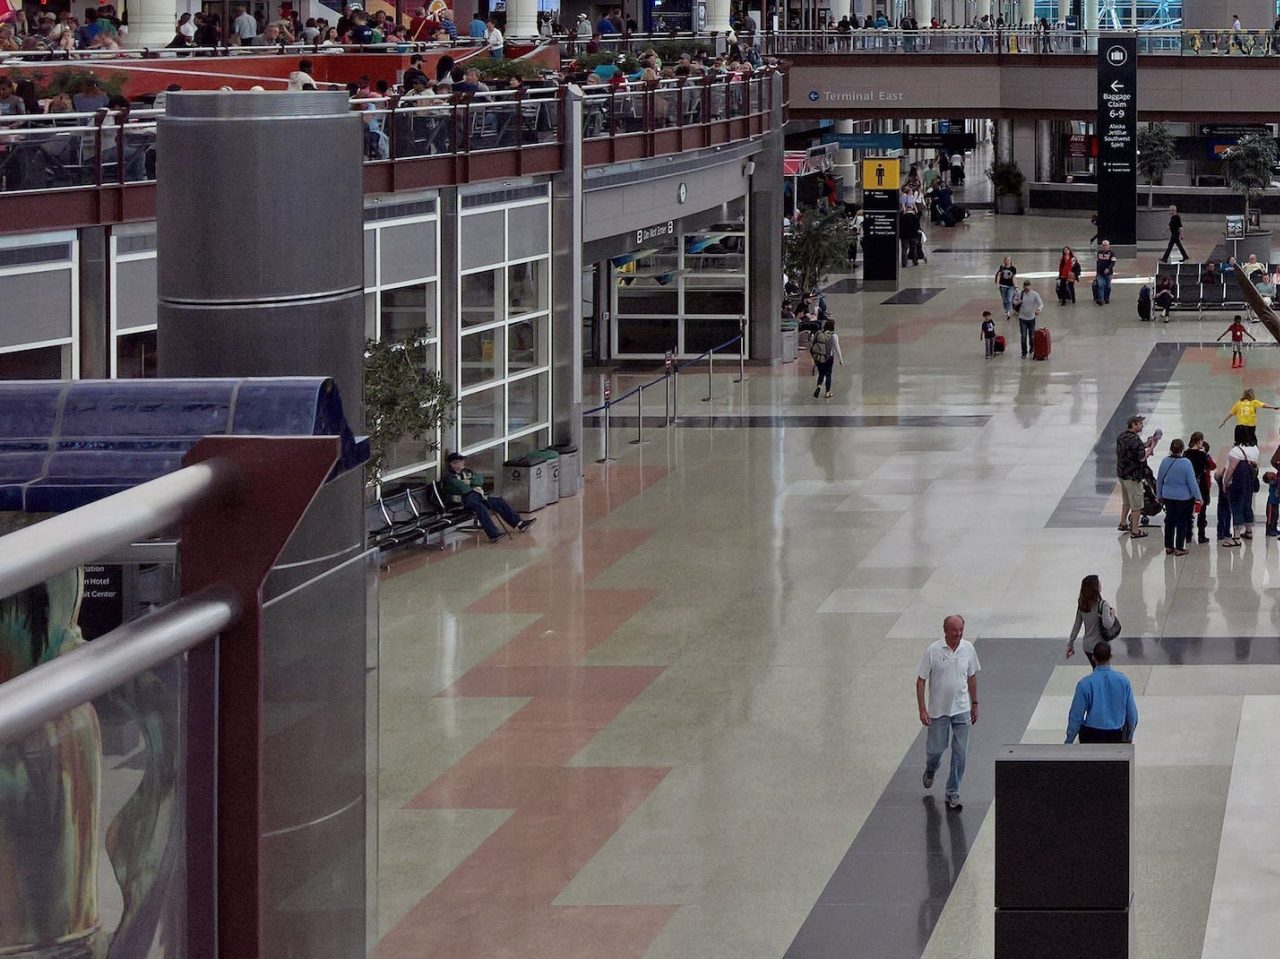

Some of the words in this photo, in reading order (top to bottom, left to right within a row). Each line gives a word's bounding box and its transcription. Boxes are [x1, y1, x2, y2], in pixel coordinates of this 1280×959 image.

[824, 91, 874, 101] Terminal
[879, 91, 904, 100] East
[1109, 109, 1125, 118] 6-9
[657, 225, 667, 236] Enter
